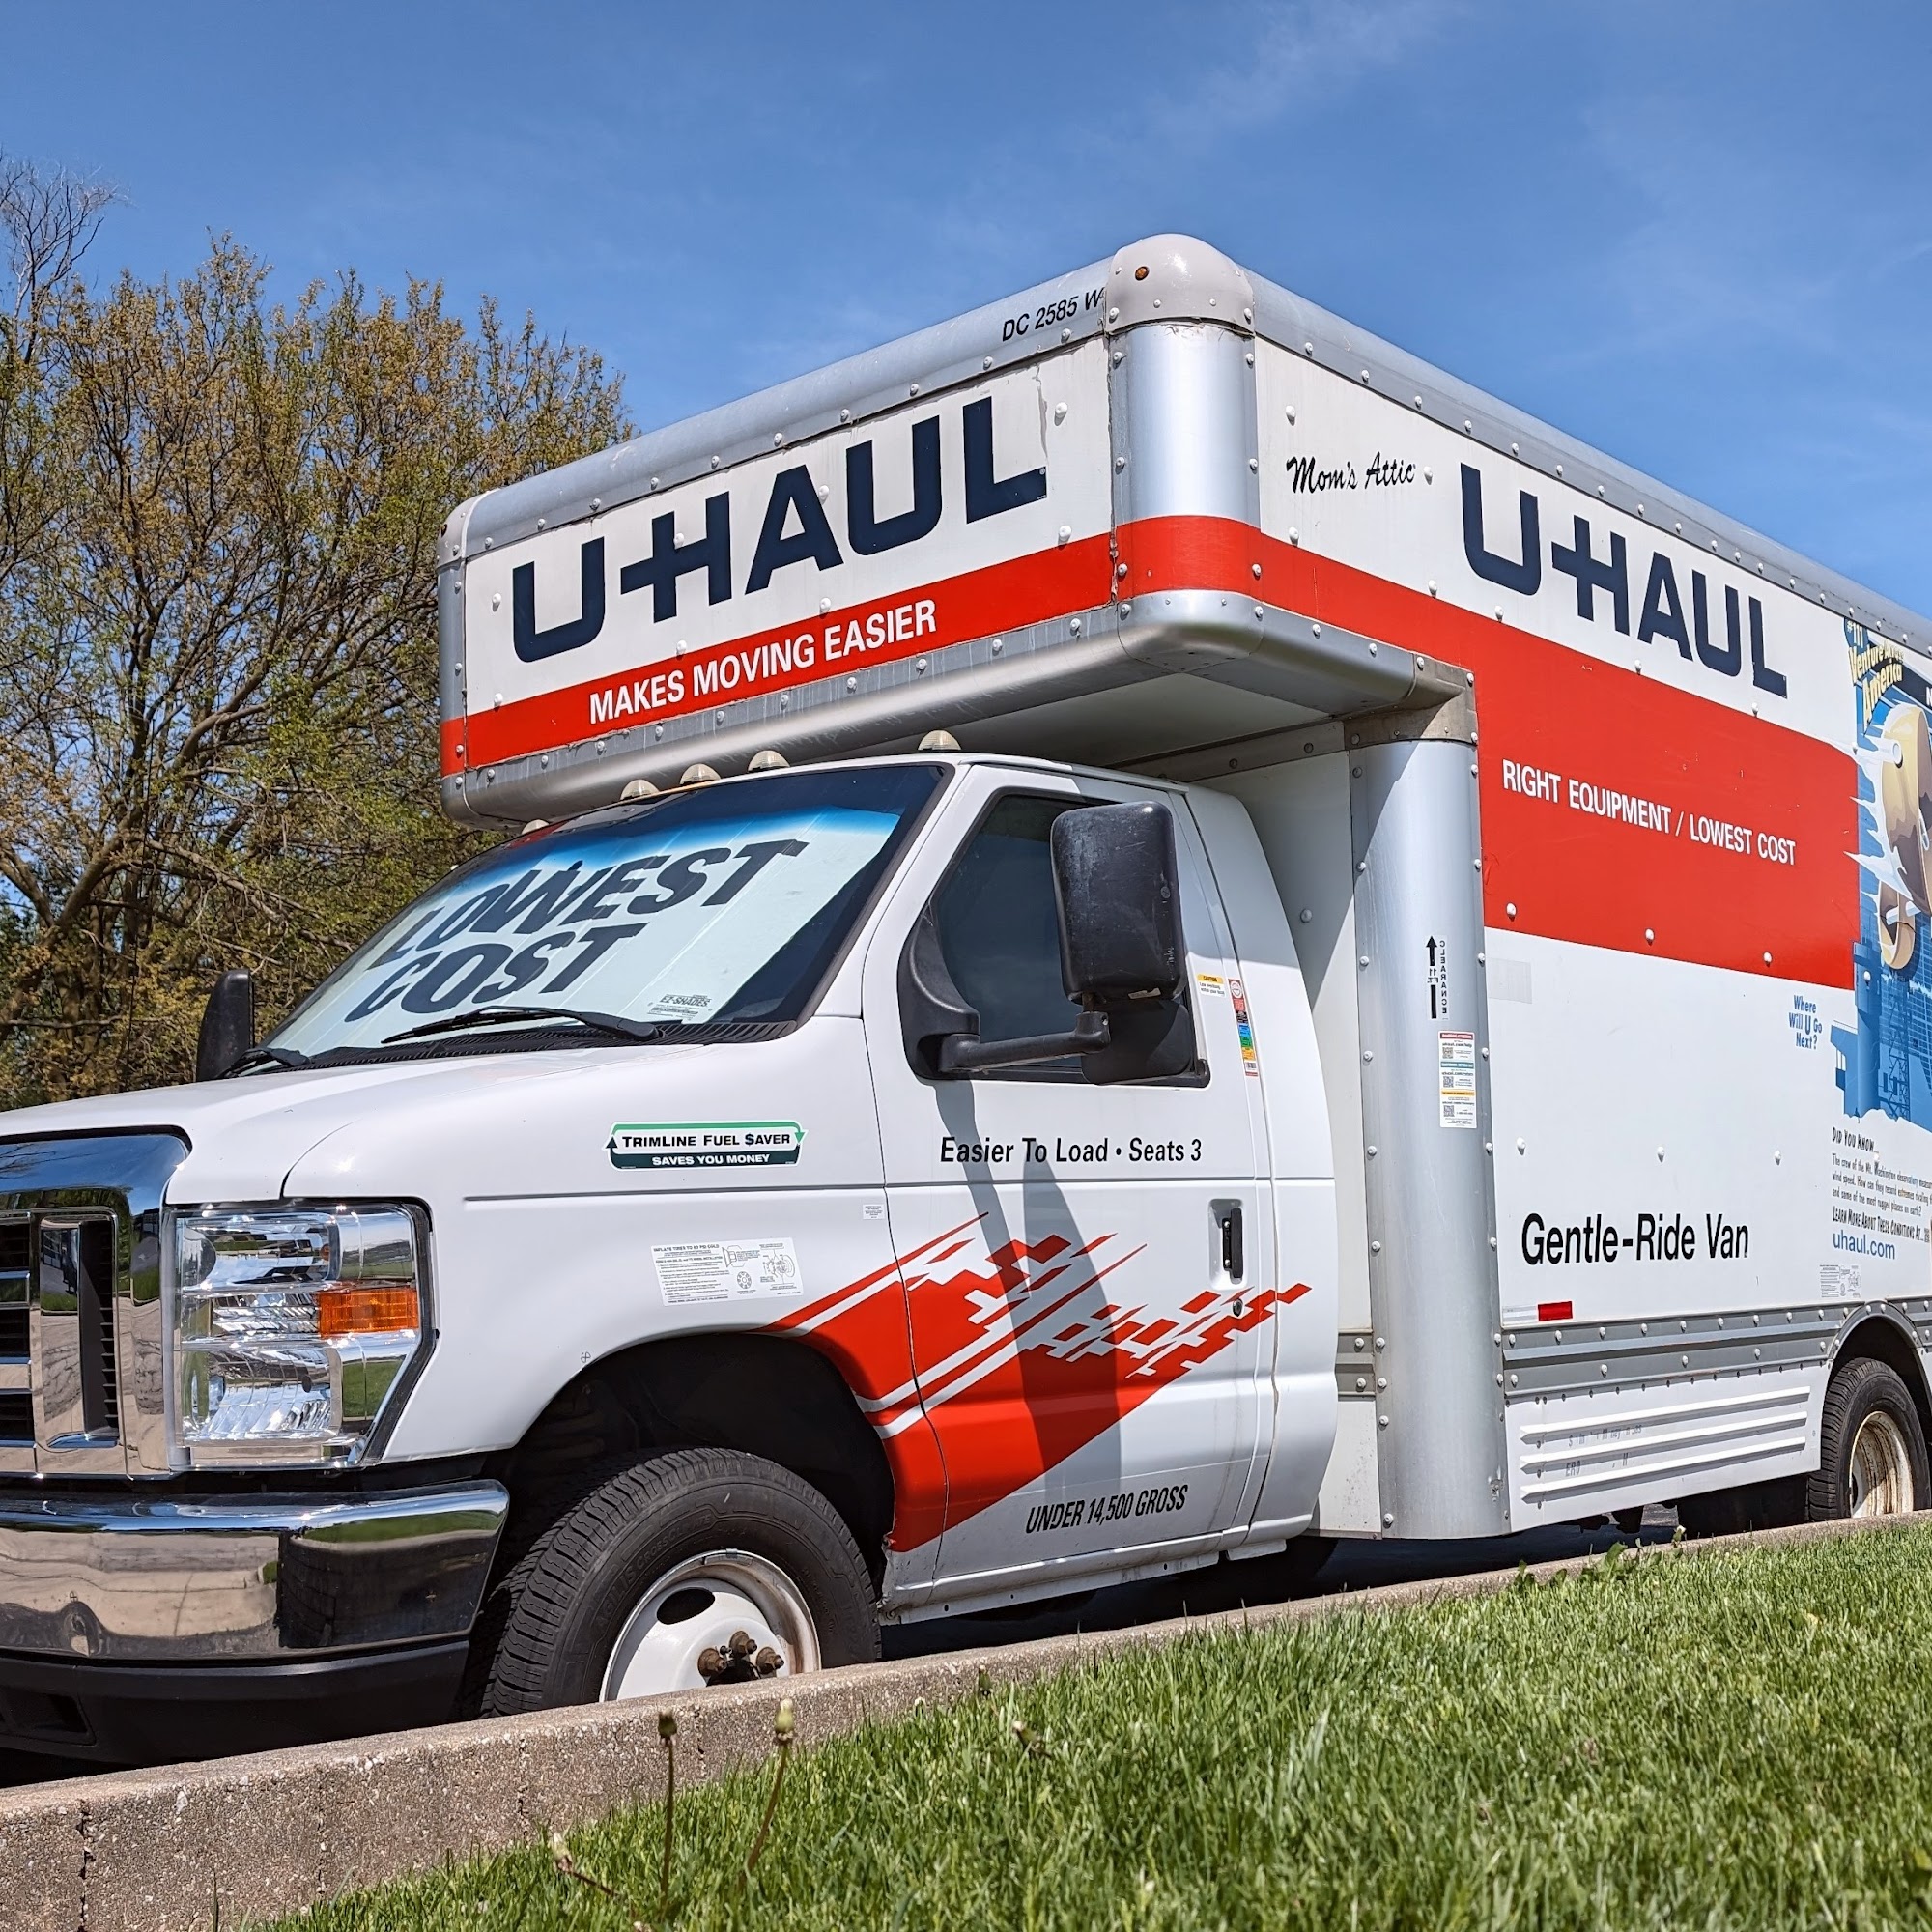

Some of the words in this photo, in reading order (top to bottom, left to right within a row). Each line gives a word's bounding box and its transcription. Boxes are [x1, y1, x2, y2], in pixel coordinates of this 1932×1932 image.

[1002, 313, 1030, 342] DC
[1035, 296, 1079, 329] 2585
[1286, 456, 1358, 494] Mom's
[1364, 451, 1416, 490] Attic
[589, 669, 685, 724] MAKES
[693, 634, 815, 696] MOVING
[824, 599, 937, 662] EASIER
[1848, 643, 1884, 686] Venture
[1862, 663, 1903, 734] America
[1502, 758, 1561, 804] RIGHT
[1568, 779, 1671, 834] EQUIPMENT
[1690, 813, 1752, 854] LOWEST
[1757, 832, 1796, 866] COST
[367, 839, 810, 972] LOWEST
[344, 922, 650, 1023] COST
[1788, 1012, 1804, 1030] Will
[1804, 1014, 1811, 1036] U
[1813, 1017, 1823, 1034] Go
[1794, 995, 1816, 1013] Where
[1796, 1031, 1818, 1050] Next?
[652, 1155, 695, 1166] SAVES
[696, 1155, 724, 1165] YOU
[726, 1154, 770, 1164] MONEY
[703, 1134, 740, 1147] FUEL
[745, 1132, 790, 1147] $AVER
[940, 1137, 1014, 1163] Easier
[1022, 1137, 1048, 1163] To
[1056, 1138, 1109, 1162] Load
[1128, 1137, 1184, 1161] Seats
[1190, 1139, 1202, 1161] 3
[1832, 1152, 1840, 1167] The
[1521, 1212, 1695, 1265] Gentle-Ride
[1706, 1213, 1749, 1258] Van
[1833, 1229, 1895, 1260] uhaul.com
[1025, 1499, 1085, 1534] UNDER
[1086, 1492, 1134, 1526] 14,500
[1135, 1484, 1188, 1517] GROSS
